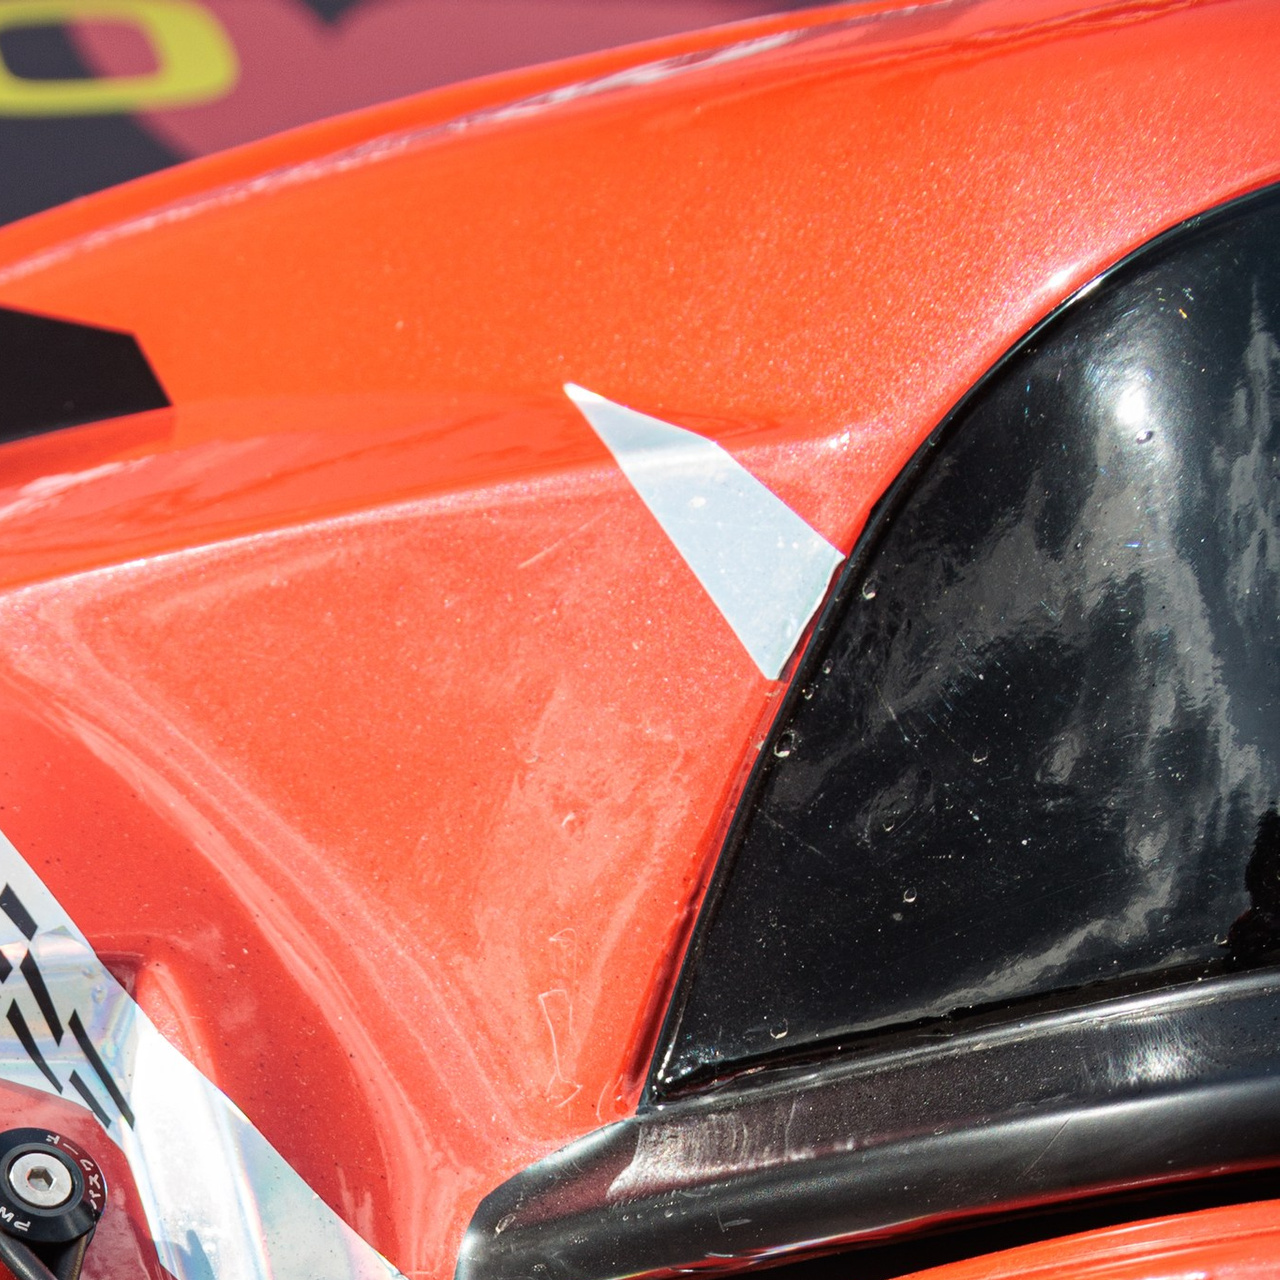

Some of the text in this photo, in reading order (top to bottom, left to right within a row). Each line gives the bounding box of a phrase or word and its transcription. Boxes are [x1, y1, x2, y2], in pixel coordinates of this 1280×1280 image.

[46, 1134, 101, 1210] パスワード
